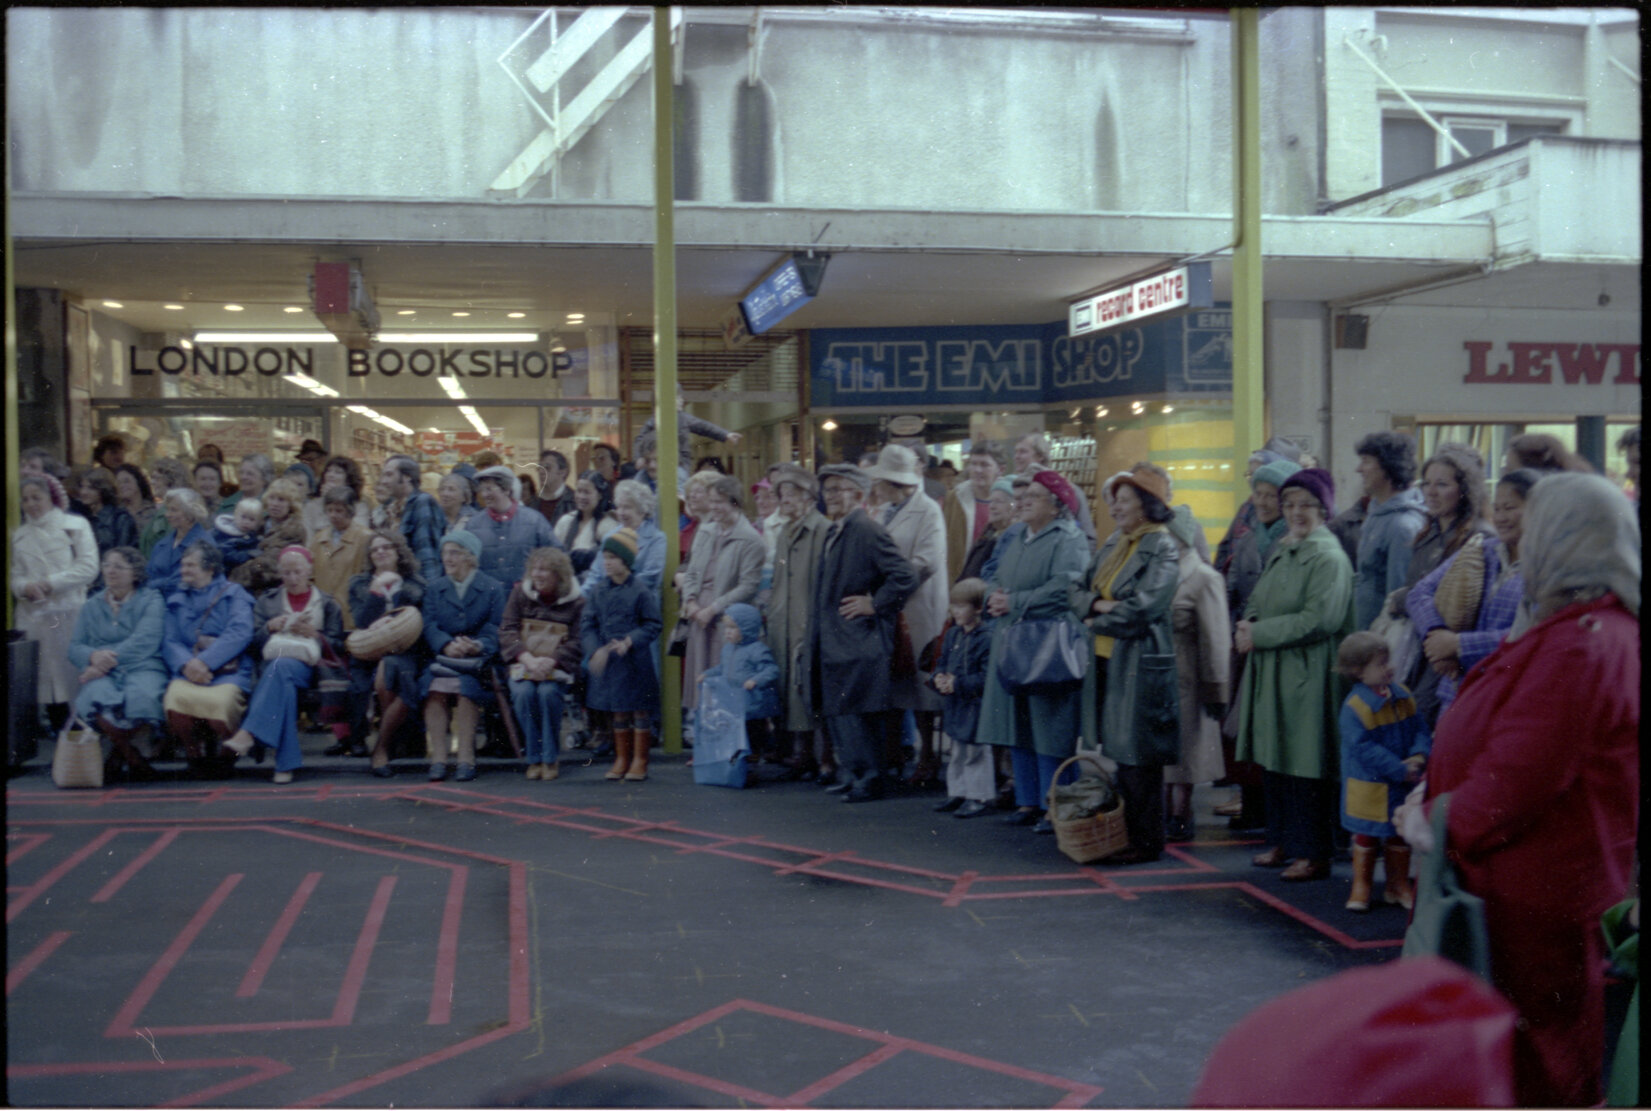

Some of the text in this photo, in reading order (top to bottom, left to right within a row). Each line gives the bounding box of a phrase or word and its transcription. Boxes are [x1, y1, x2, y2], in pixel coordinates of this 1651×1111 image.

[1096, 284, 1134, 324] record
[1138, 273, 1184, 311] centre
[130, 345, 574, 380] LONDON BOOKSHOP
[828, 326, 1144, 393] THE EMI SHOP
